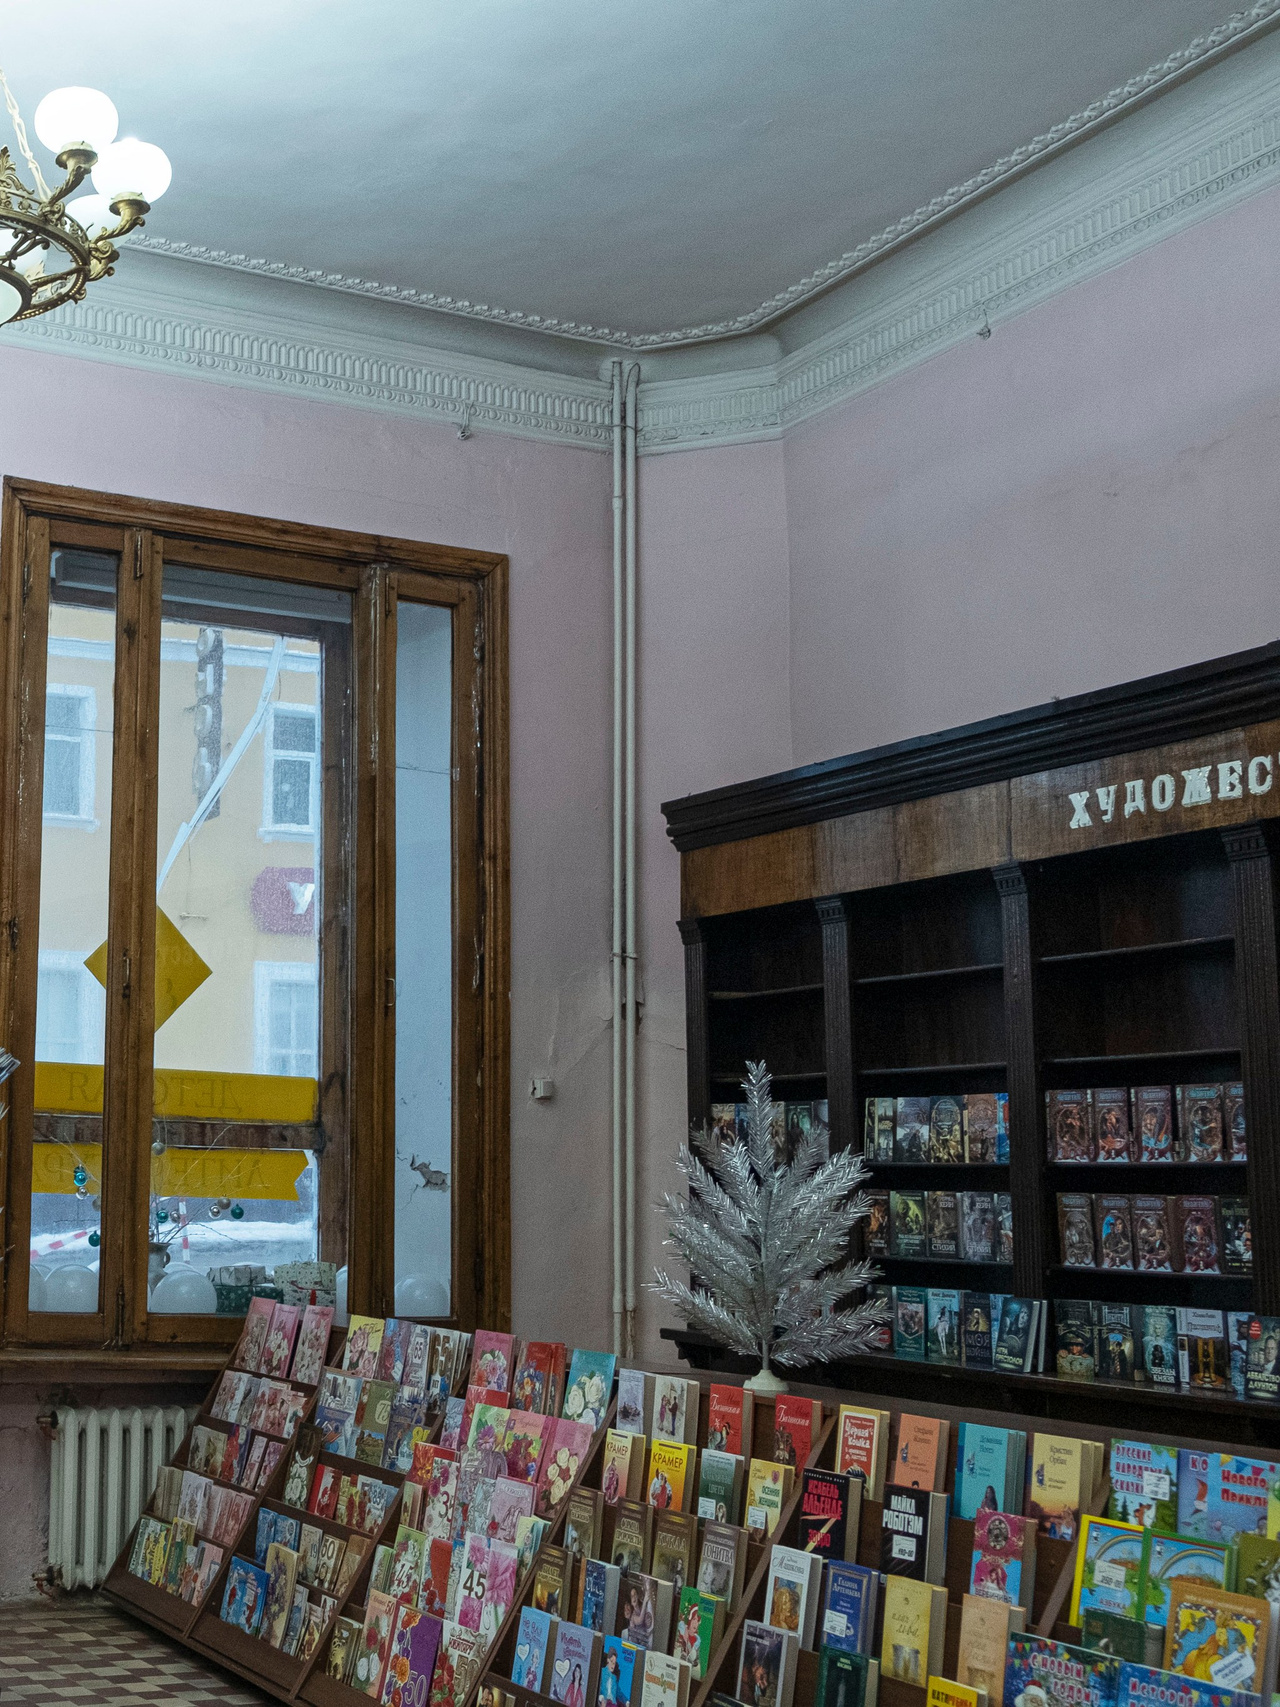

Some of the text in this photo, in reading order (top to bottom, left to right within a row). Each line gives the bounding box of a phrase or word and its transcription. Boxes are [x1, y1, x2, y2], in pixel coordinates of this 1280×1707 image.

[1068, 753, 1280, 829] ХУДОЖЕС
[966, 1333, 991, 1347] МОЯ
[606, 1441, 629, 1456] КРАМЕР
[1114, 1443, 1152, 1462] РУССКИЕ
[652, 1452, 684, 1469] КРАМЕР
[808, 1479, 839, 1499] ИСАБЕЛЬ
[802, 1493, 843, 1520] АЛЬЕНДЕ
[890, 1494, 916, 1515] МАЙКЛ
[882, 1508, 924, 1536] РОБОТЭМ
[703, 1542, 734, 1565] ГОНИТВА
[463, 1569, 486, 1600] 45
[1030, 1651, 1085, 1682] С НОВЫМ
[404, 1670, 428, 1707] 50
